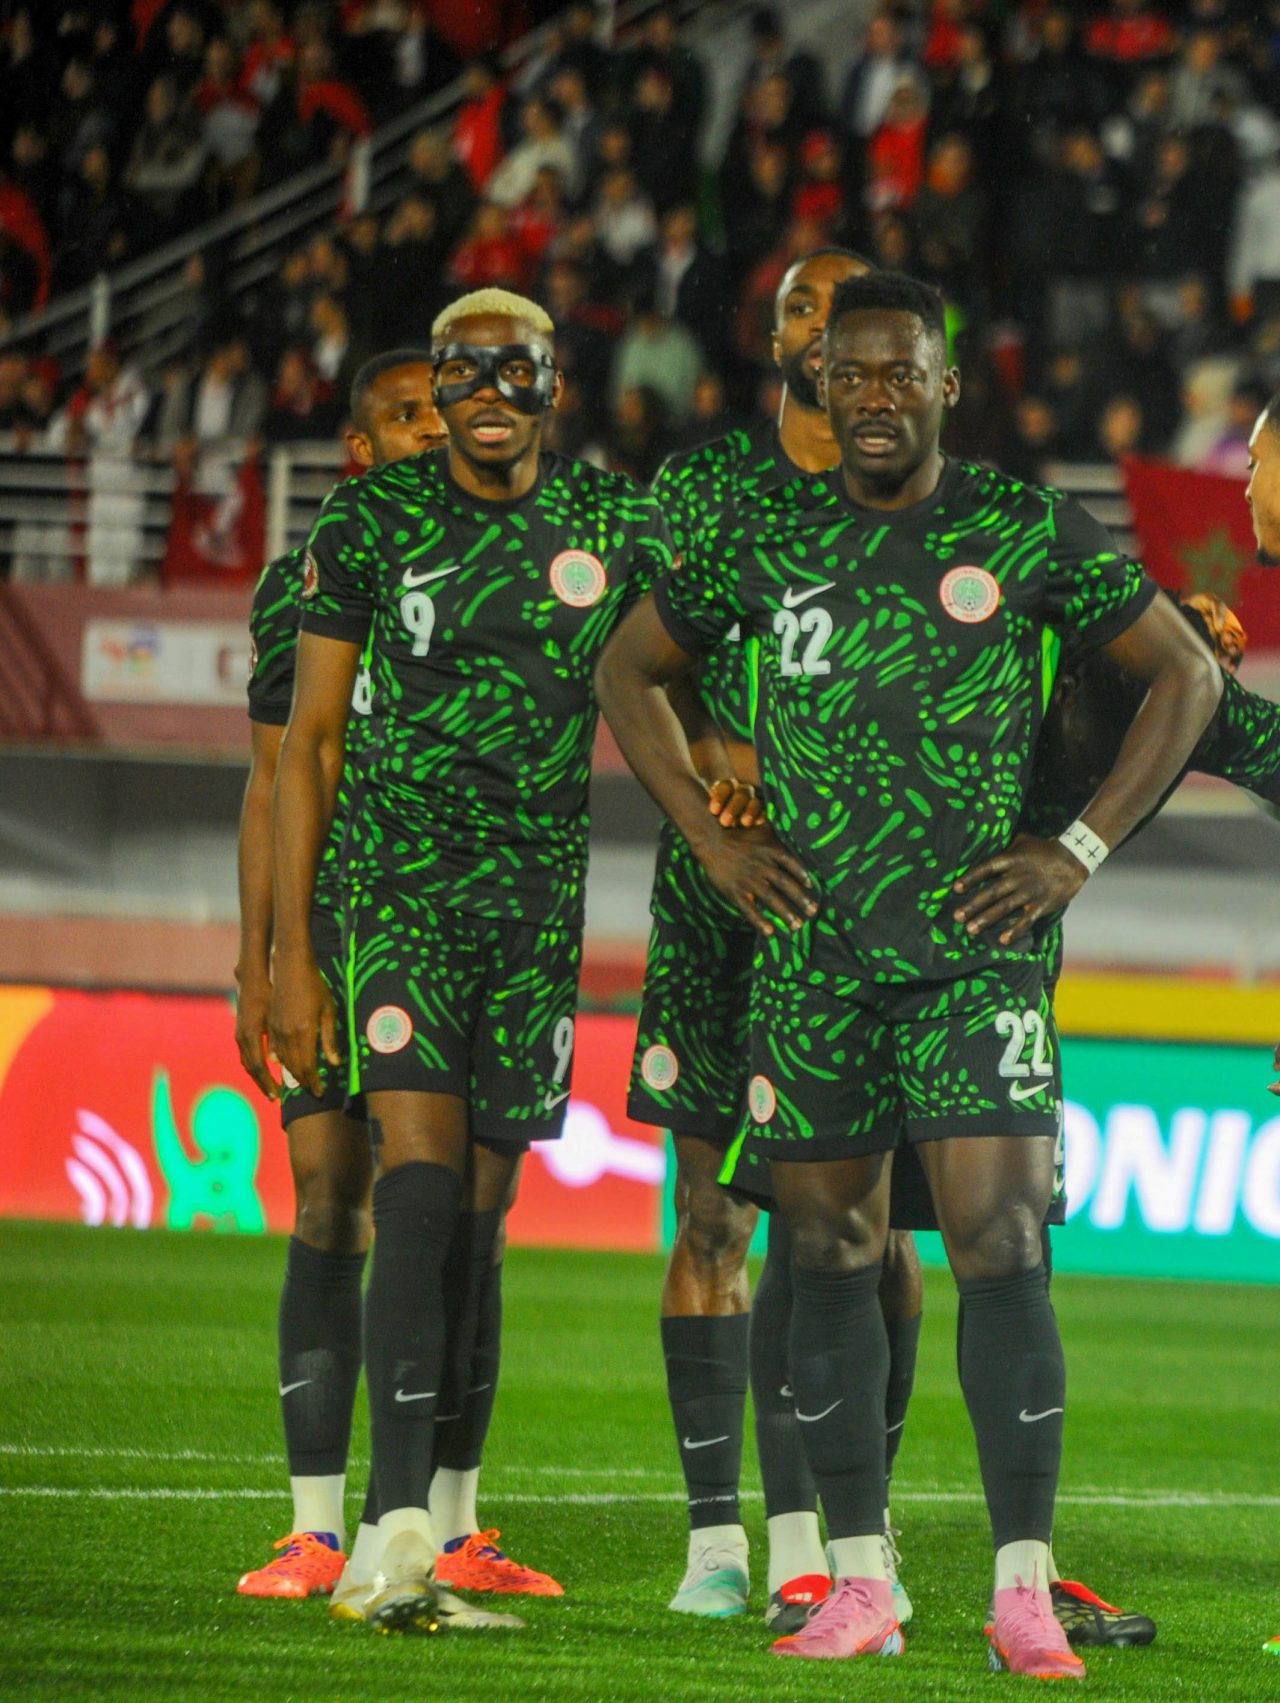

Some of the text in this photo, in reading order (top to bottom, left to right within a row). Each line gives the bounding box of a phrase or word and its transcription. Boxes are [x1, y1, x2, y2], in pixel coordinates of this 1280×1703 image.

[401, 591, 435, 656] 9
[773, 607, 833, 676] 22
[553, 1016, 574, 1084] 9
[995, 1009, 1053, 1077] 22
